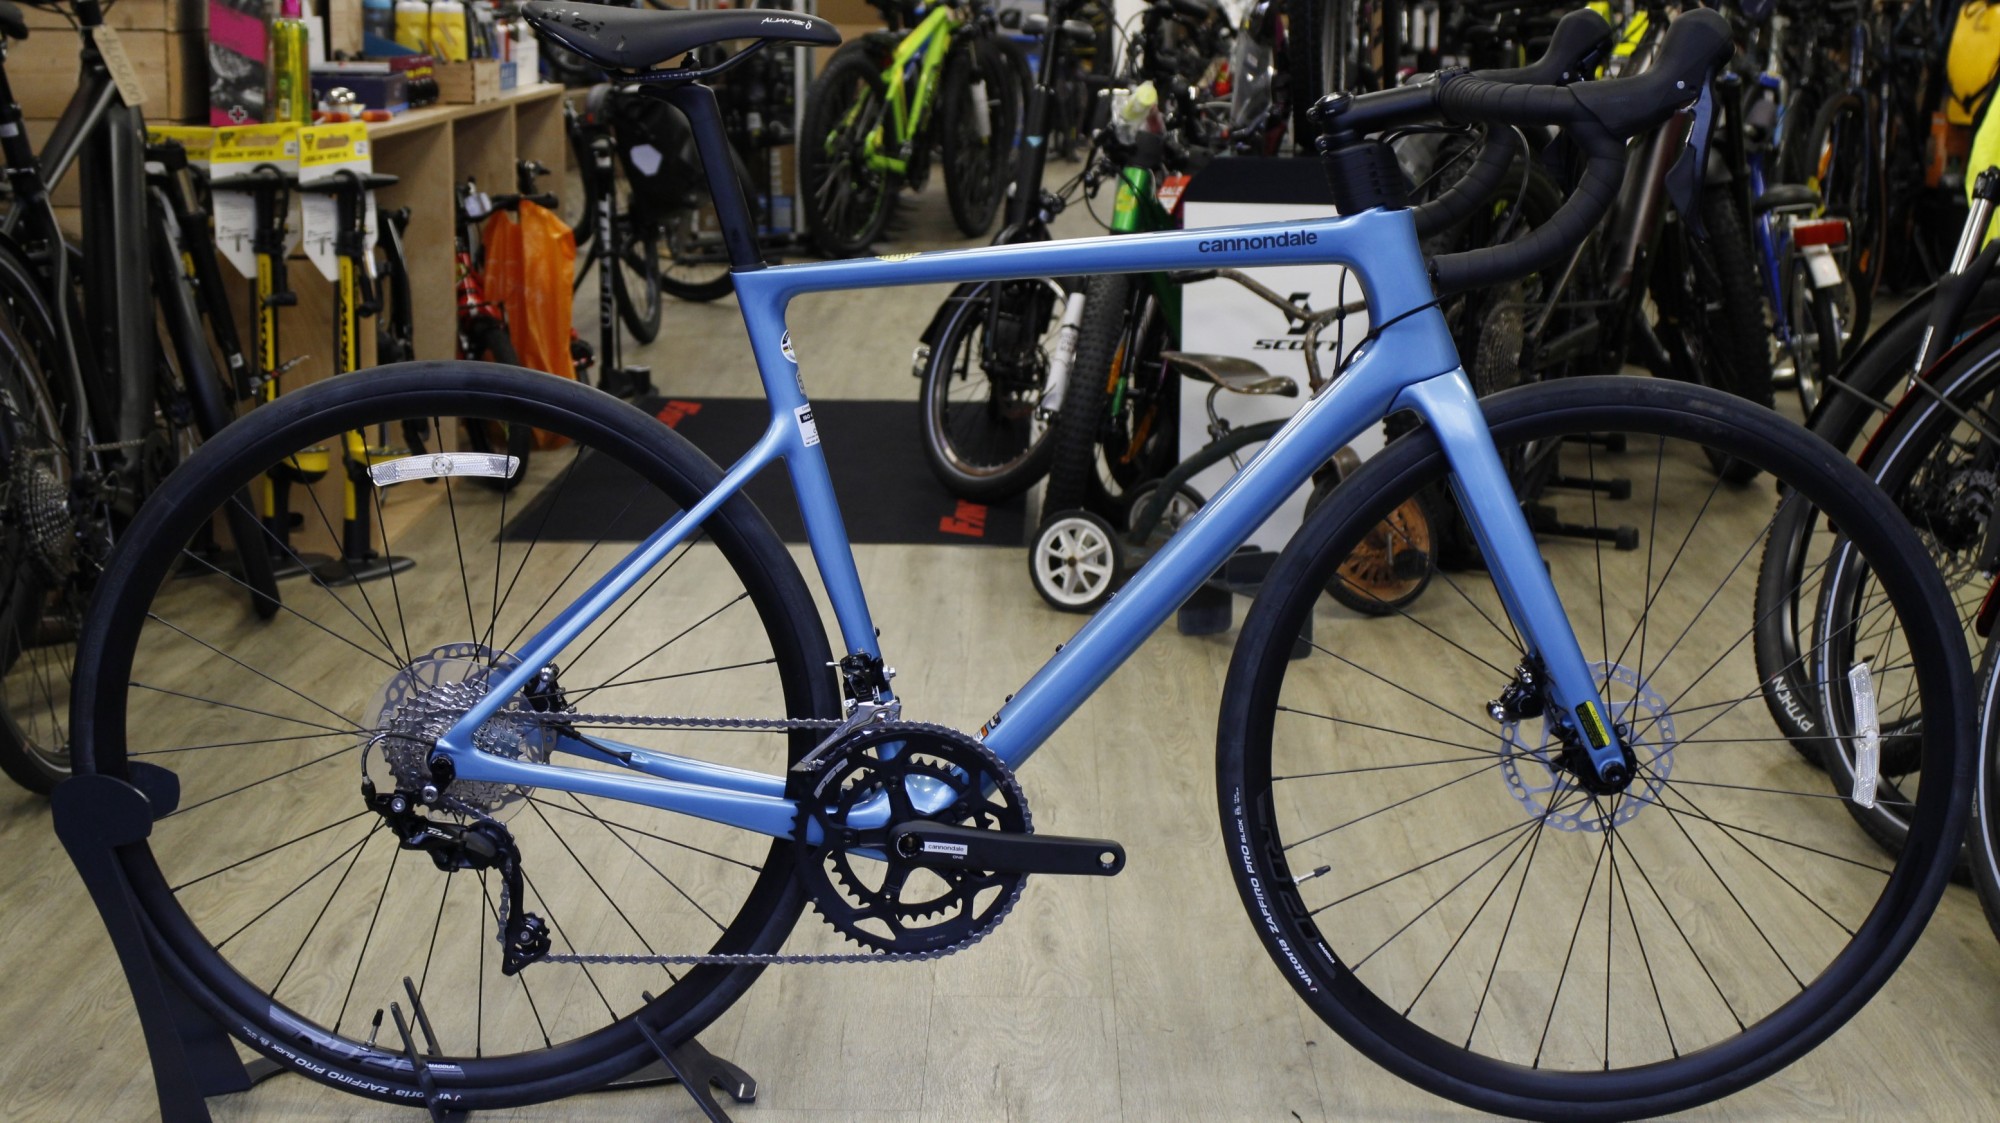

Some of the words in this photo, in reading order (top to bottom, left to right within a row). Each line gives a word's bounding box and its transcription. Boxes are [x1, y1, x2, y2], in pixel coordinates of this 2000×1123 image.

[1198, 229, 1318, 253] cannondale
[1772, 676, 1815, 732] PYTHON
[1237, 819, 1247, 843] SLICK
[928, 844, 965, 852] cannondale
[1241, 845, 1255, 874] PRO
[1250, 877, 1280, 934] ZAFFIRO
[1278, 938, 1312, 986] vittoria
[271, 1044, 296, 1060] SLICK
[295, 1057, 326, 1075] PRO
[327, 1071, 389, 1094] ZAFFIRO
[395, 1089, 452, 1100] vioria
